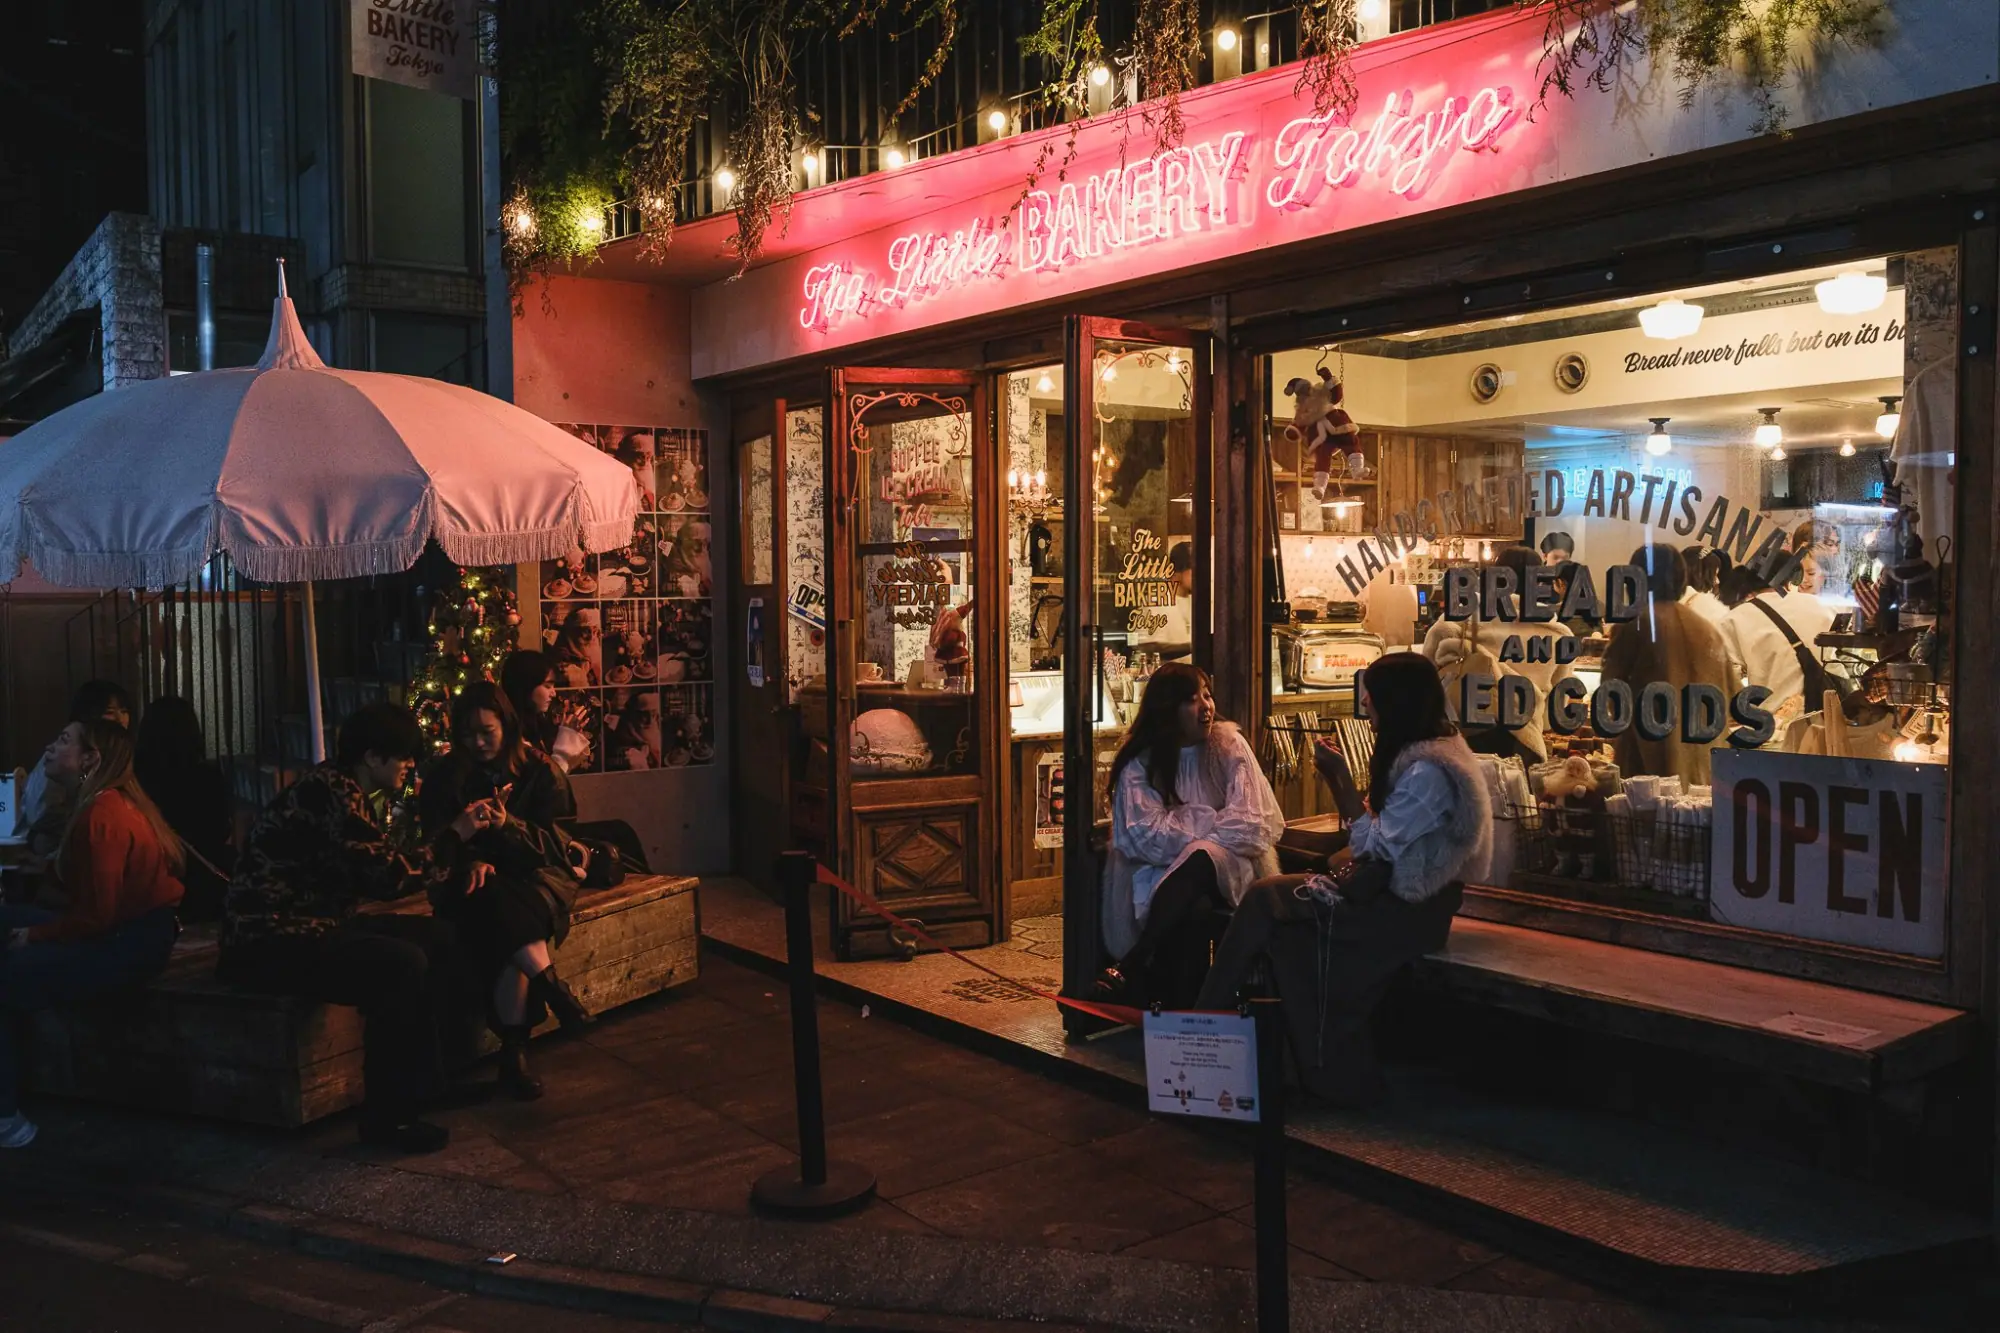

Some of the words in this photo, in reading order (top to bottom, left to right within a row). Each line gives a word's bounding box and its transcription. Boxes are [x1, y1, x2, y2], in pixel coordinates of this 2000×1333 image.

[367, 8, 460, 57] BAKERY
[386, 44, 444, 77] Tokyo
[800, 262, 864, 328] The
[880, 217, 1000, 304] Little
[1019, 130, 1245, 272] BAKERY
[1267, 88, 1511, 208] Tokyo
[1624, 347, 1681, 374] Bread
[1683, 345, 1733, 365] never
[1733, 334, 1782, 366] falls
[1785, 330, 1823, 354] but
[1825, 330, 1852, 347] on
[1854, 322, 1880, 345] its
[1132, 528, 1161, 553] The
[1335, 469, 1566, 598] HANDCRAFTED
[1118, 552, 1175, 581] Little
[1114, 581, 1179, 608] BAKERY
[1443, 562, 1649, 624] BREAD
[1127, 608, 1168, 635] Tokyo
[1324, 656, 1367, 668] FAEMA
[1499, 634, 1582, 664] AND
[1547, 676, 1776, 749] GOODS
[1732, 778, 1923, 923] OPEN
